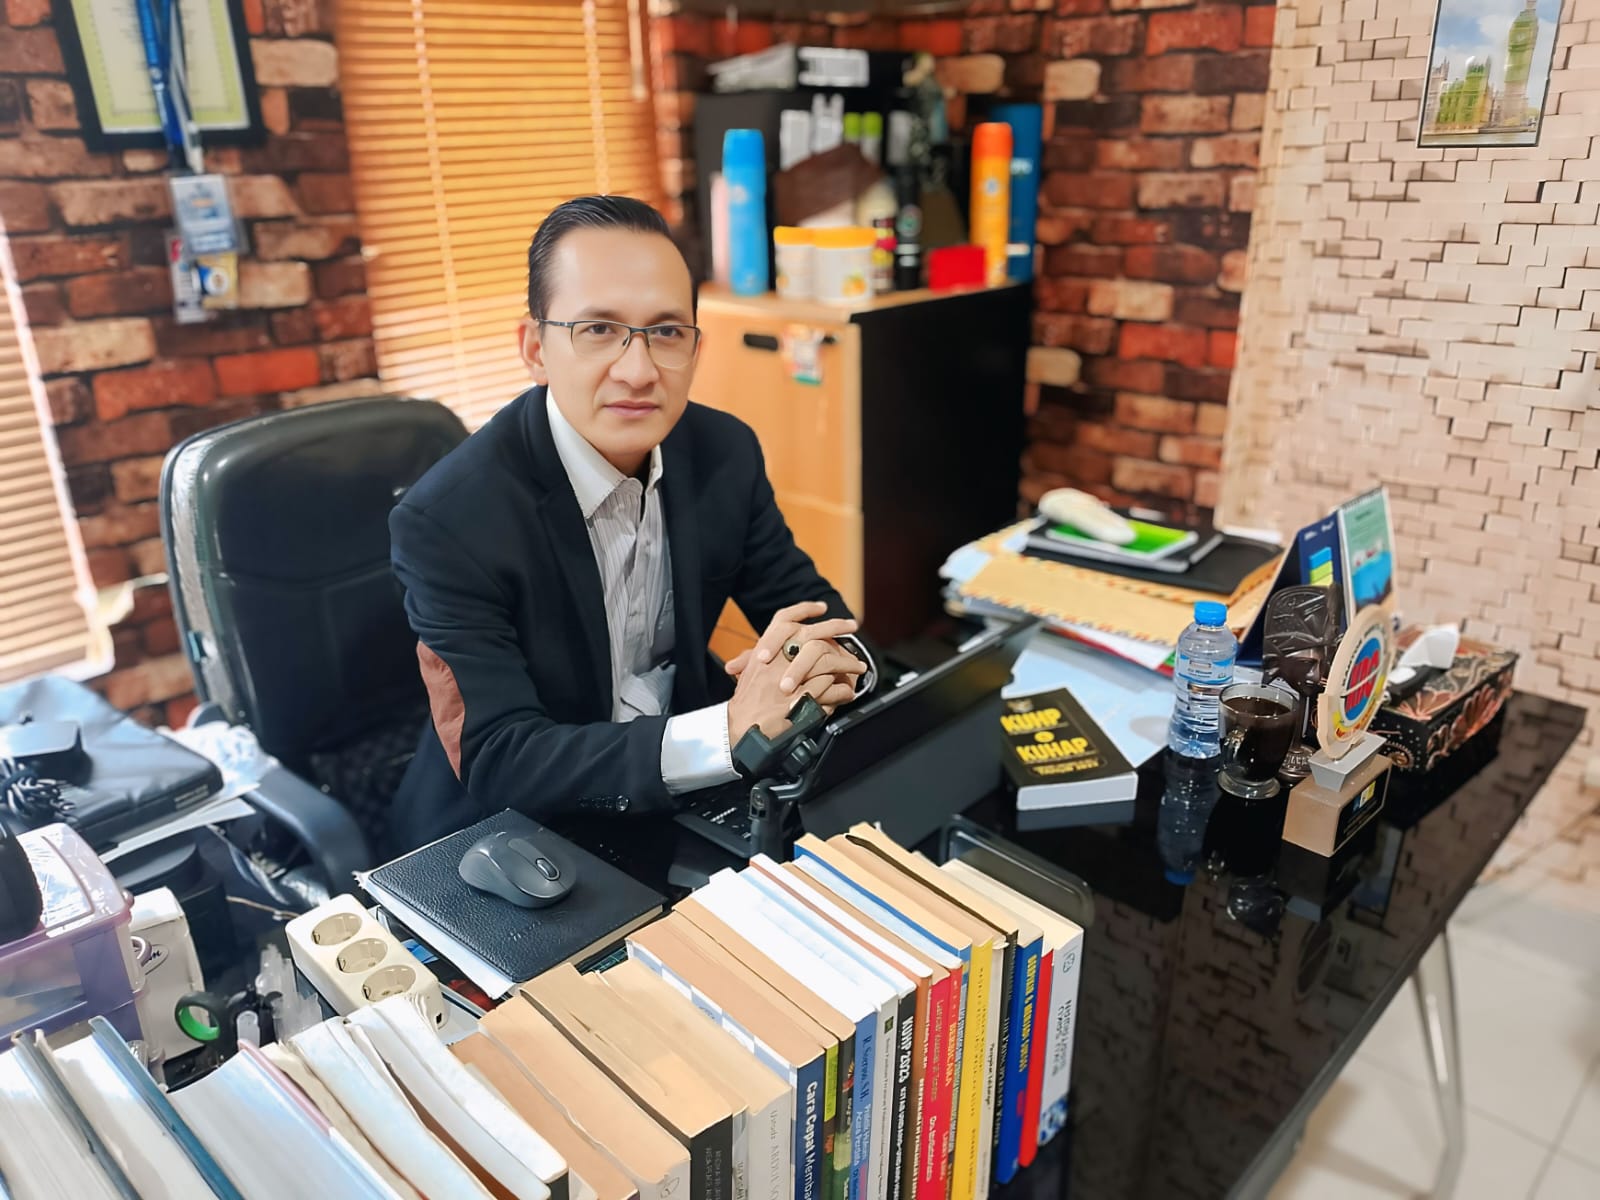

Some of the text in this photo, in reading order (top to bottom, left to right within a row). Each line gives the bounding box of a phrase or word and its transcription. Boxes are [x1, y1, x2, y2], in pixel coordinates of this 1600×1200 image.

[1000, 708, 1062, 733] KUHP
[1016, 737, 1089, 762] KUHAP
[901, 1016, 914, 1050] KUHP
[898, 1050, 912, 1083] 2023
[803, 1081, 818, 1200] Cara Cepat Memba
